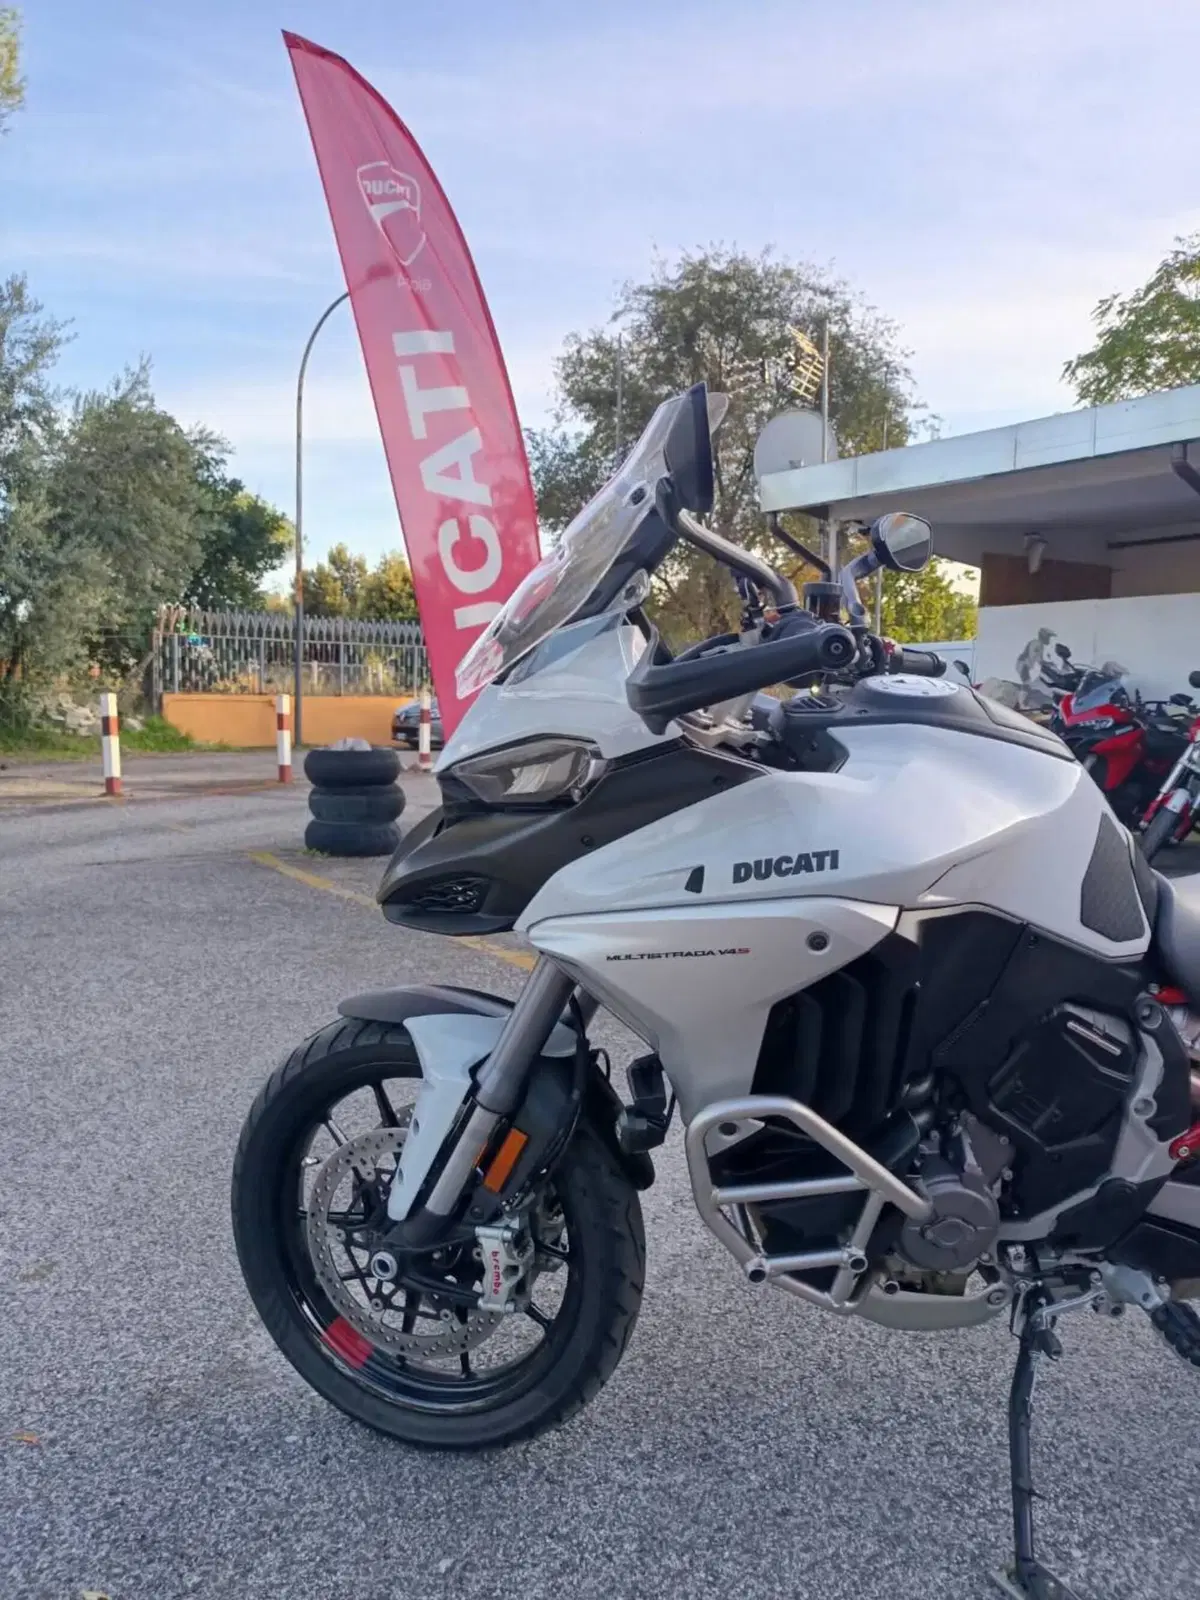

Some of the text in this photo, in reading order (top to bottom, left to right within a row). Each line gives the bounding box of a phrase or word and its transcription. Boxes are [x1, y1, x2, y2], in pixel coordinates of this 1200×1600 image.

[732, 849, 839, 884] DUCATI
[606, 947, 752, 961] MULTISTRADA V4S
[491, 1250, 502, 1295] brembo
